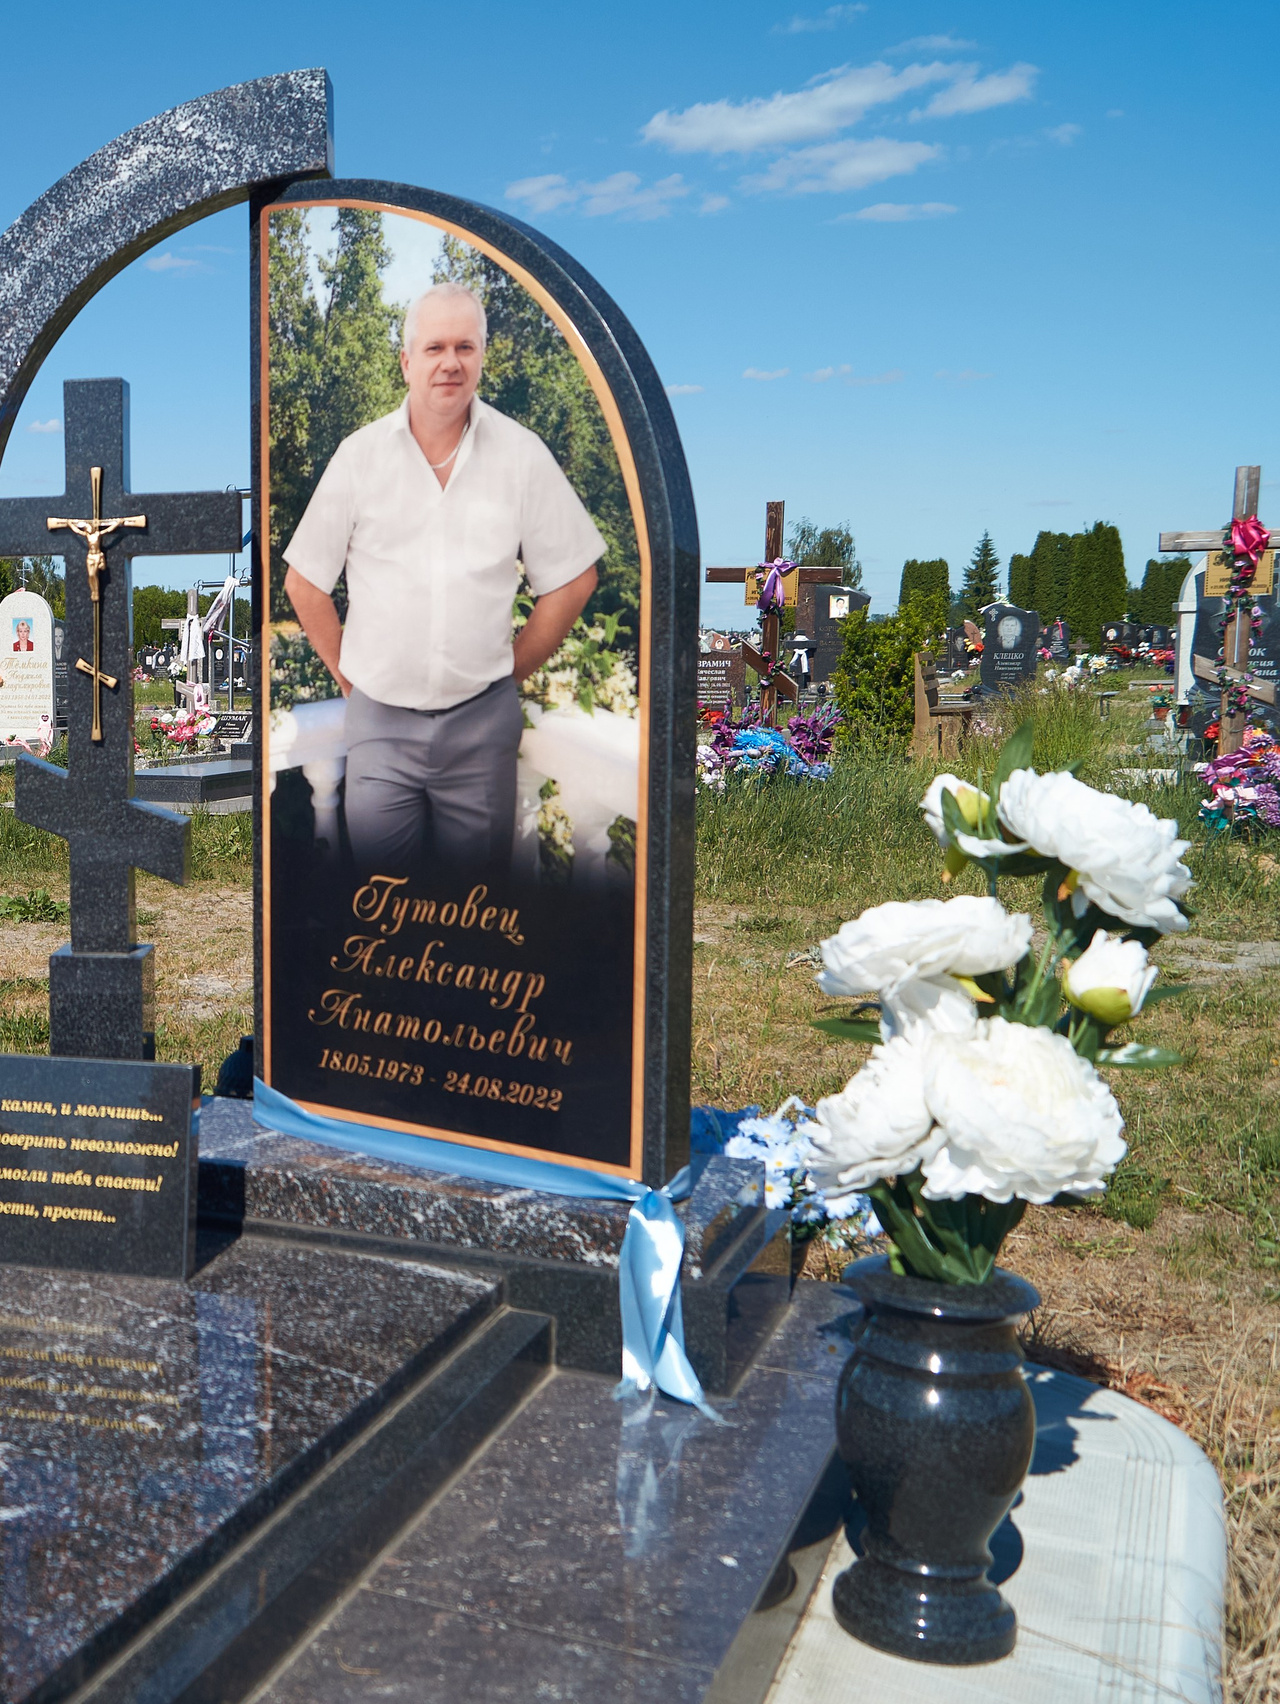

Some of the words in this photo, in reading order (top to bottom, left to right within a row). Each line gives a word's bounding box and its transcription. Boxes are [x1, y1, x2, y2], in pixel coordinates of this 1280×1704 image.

[993, 652, 1024, 660] КЛЕЦКО
[350, 875, 524, 947] Гутовец
[329, 934, 545, 1014] Александр
[309, 989, 572, 1066] Анатольевич
[320, 1049, 424, 1084] 18.05.1973
[444, 1072, 562, 1111] 24.08.2022
[1, 1100, 57, 1115] камня,
[61, 1104, 71, 1115] и
[74, 1105, 163, 1122] молчишь...
[71, 1138, 179, 1157] невозможно!
[51, 1170, 92, 1186] тебя
[95, 1175, 163, 1191] спасти!
[42, 1205, 116, 1222] прости...
